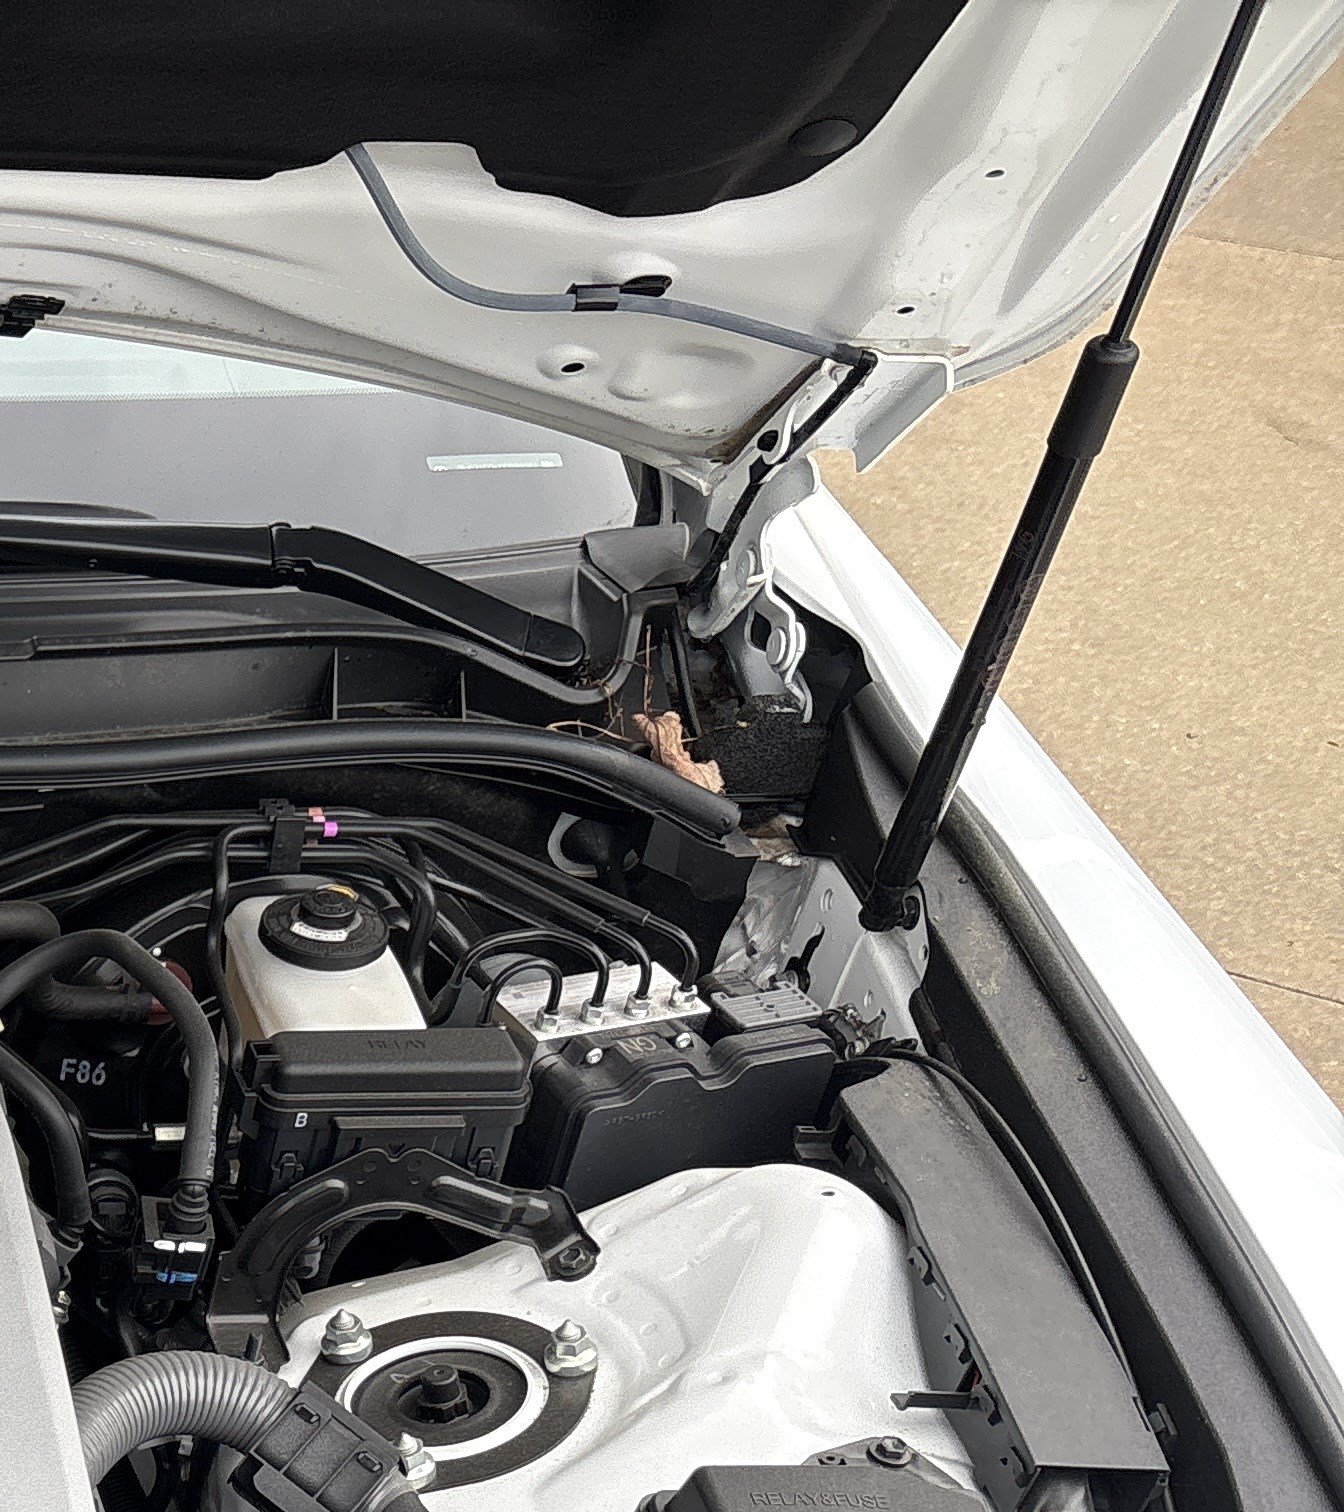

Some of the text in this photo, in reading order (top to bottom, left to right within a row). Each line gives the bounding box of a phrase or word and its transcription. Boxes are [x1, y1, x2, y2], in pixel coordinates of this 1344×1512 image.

[59, 1058, 107, 1086] F86
[293, 1112, 308, 1128] B
[749, 1491, 892, 1511] RELAY&FUSE
